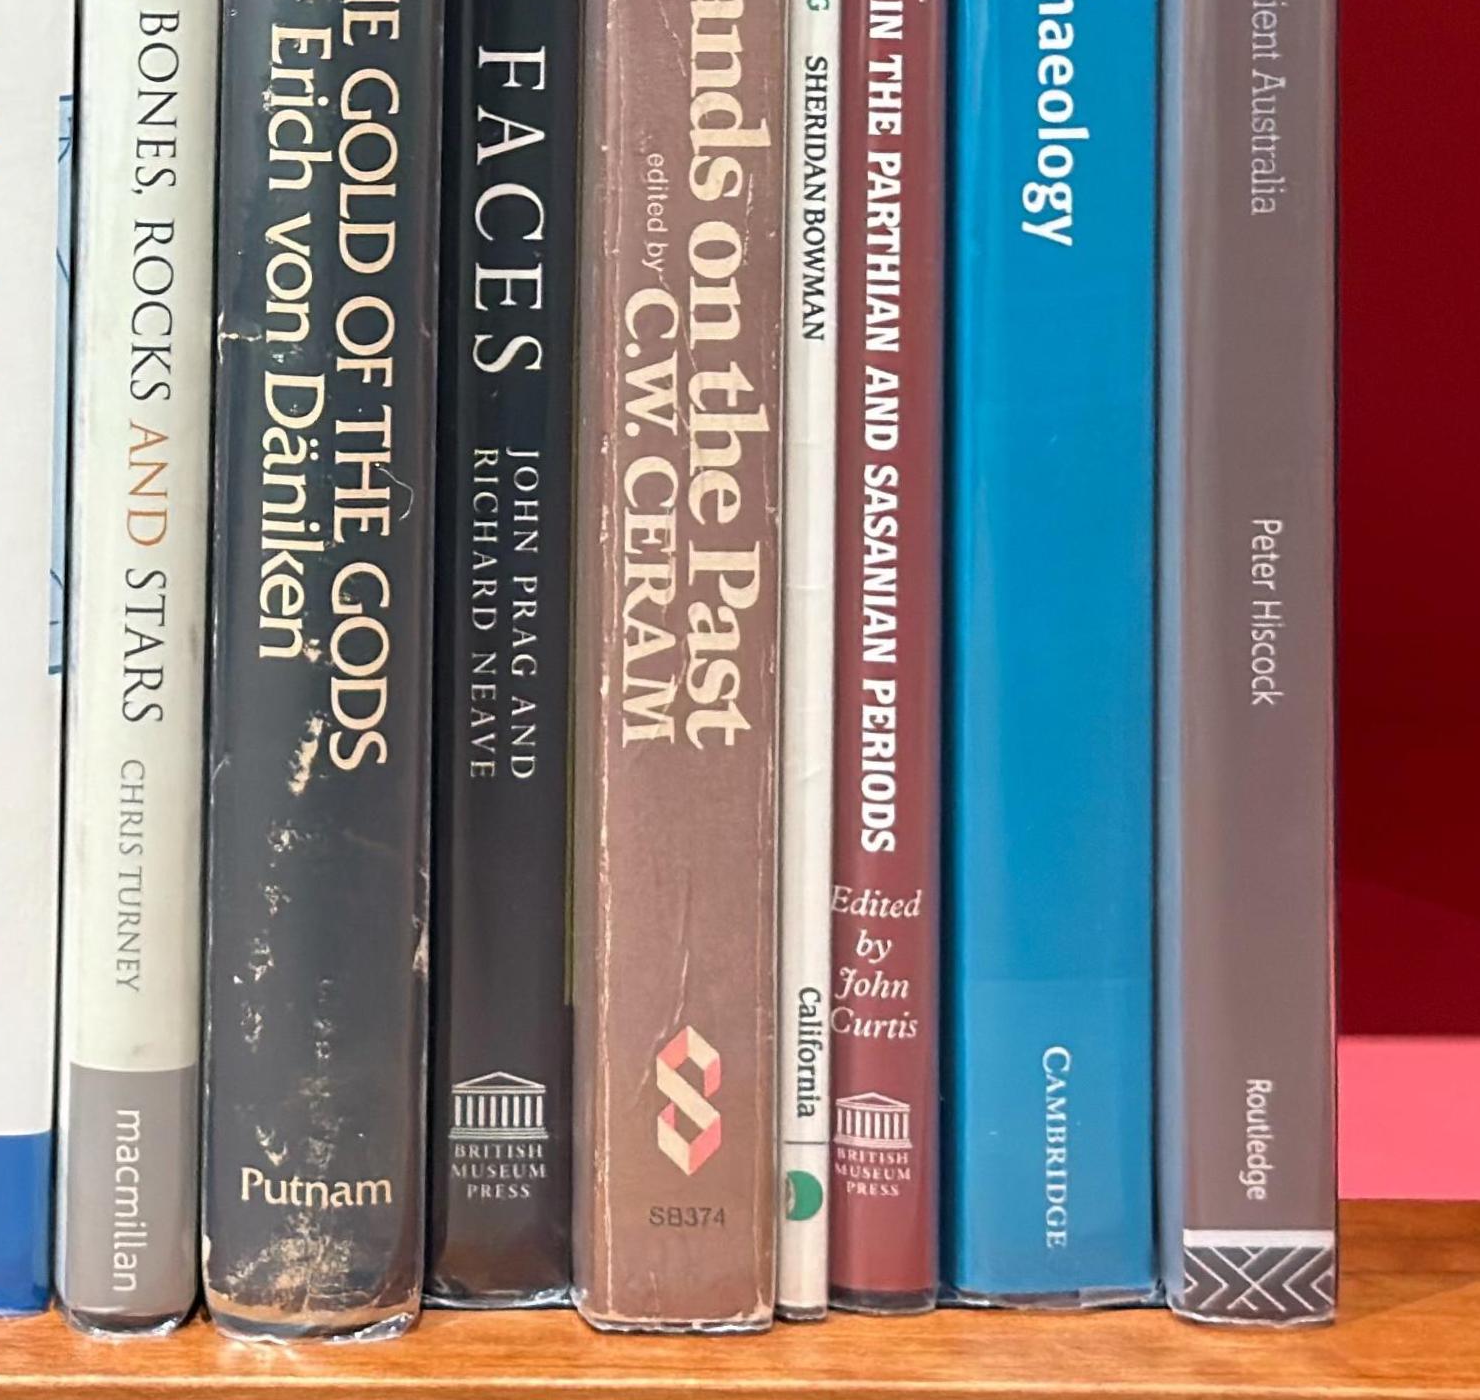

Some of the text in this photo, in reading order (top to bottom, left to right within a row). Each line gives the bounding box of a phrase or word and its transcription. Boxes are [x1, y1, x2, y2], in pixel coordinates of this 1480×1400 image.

[869, 3, 904, 39] IN
[802, 56, 828, 202] SHERIDAN
[867, 51, 903, 136] THE
[1250, 67, 1285, 217] Australia
[336, 69, 399, 275] GOLD
[473, 45, 546, 375] FACES
[641, 152, 670, 273] edited by
[688, 219, 744, 352] on
[801, 209, 825, 341] BOWMAN
[863, 150, 902, 352] PARTHIAN
[259, 23, 332, 661] Erich von Däniken
[336, 295, 395, 387] OF
[333, 402, 394, 543] THE
[688, 359, 770, 525] the
[865, 365, 899, 450] AND
[115, 9, 181, 993] BONES, ROCKS AND STARS CHRIS TURNEY
[862, 465, 899, 664] SASANIAN
[330, 562, 390, 771] GODS
[469, 448, 498, 779] RICHARD NEAVE
[506, 448, 539, 780] JOHN PRAG AND
[686, 544, 760, 749] Past
[1251, 516, 1283, 706] Peter Hiscock
[859, 678, 897, 852] PERIODS
[831, 886, 921, 917] Edited
[856, 930, 892, 962] by
[830, 1007, 917, 1038] Curtis
[835, 967, 909, 999] John
[796, 988, 823, 1118] California
[115, 1110, 148, 1292] macmillan
[242, 1167, 391, 1208] Putnam
[451, 1163, 546, 1178] MUSEUM
[454, 1144, 543, 1157] BRITISH
[467, 1183, 531, 1198] PRESS
[846, 1181, 900, 1196] PRESS
[1244, 1079, 1272, 1202] Routledge
[648, 1207, 726, 1229] SB374
